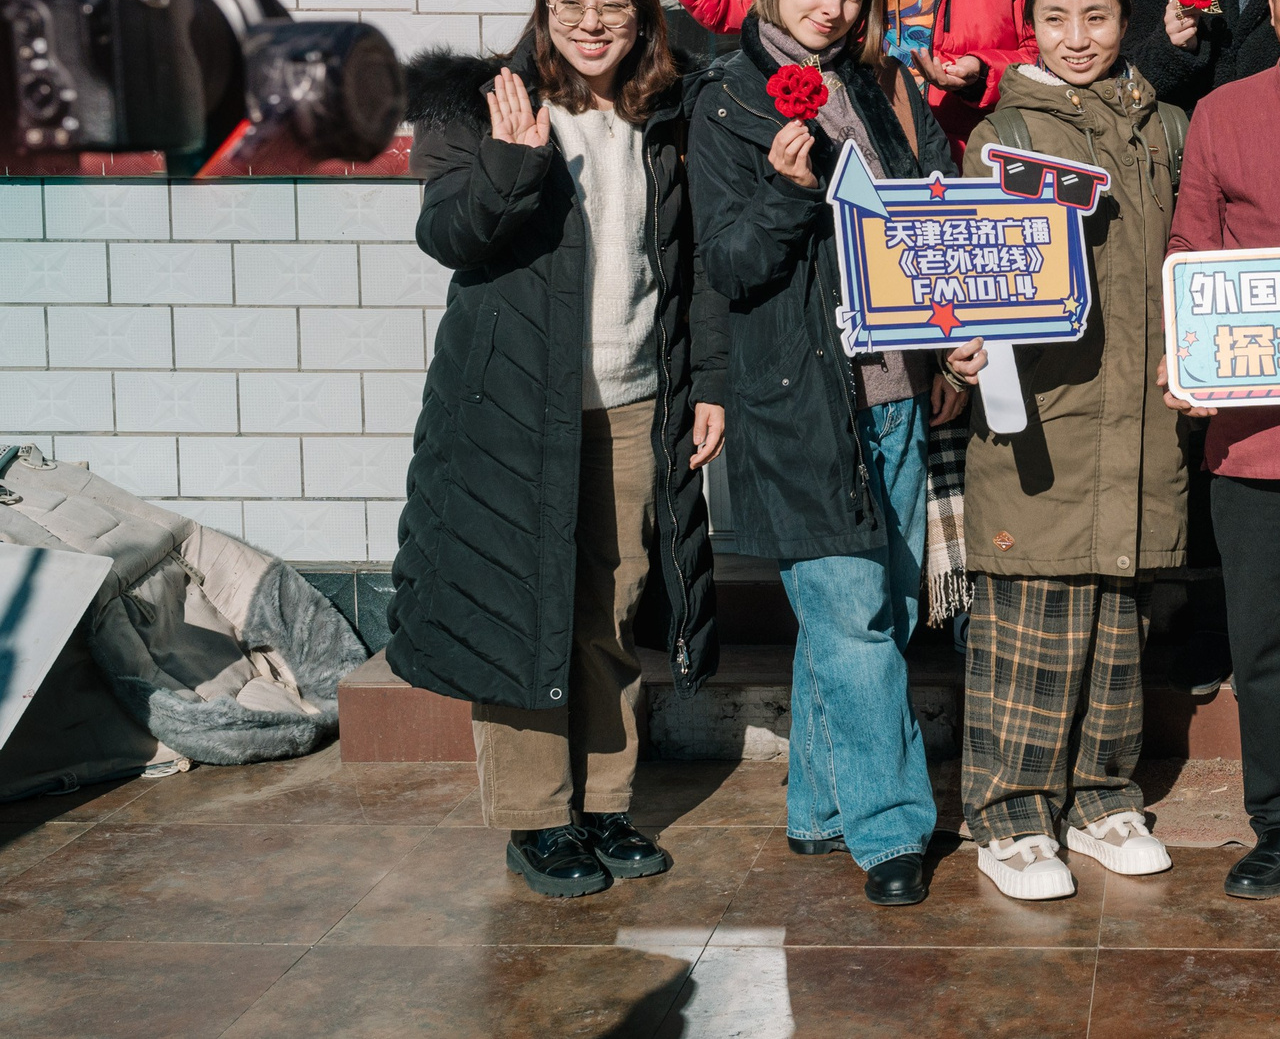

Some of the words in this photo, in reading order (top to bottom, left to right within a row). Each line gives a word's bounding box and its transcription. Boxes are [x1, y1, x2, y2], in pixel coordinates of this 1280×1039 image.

[885, 217, 1051, 247] 天津经济广播
[899, 246, 1044, 276] 《老外视线》
[912, 275, 1037, 304] FM101.4
